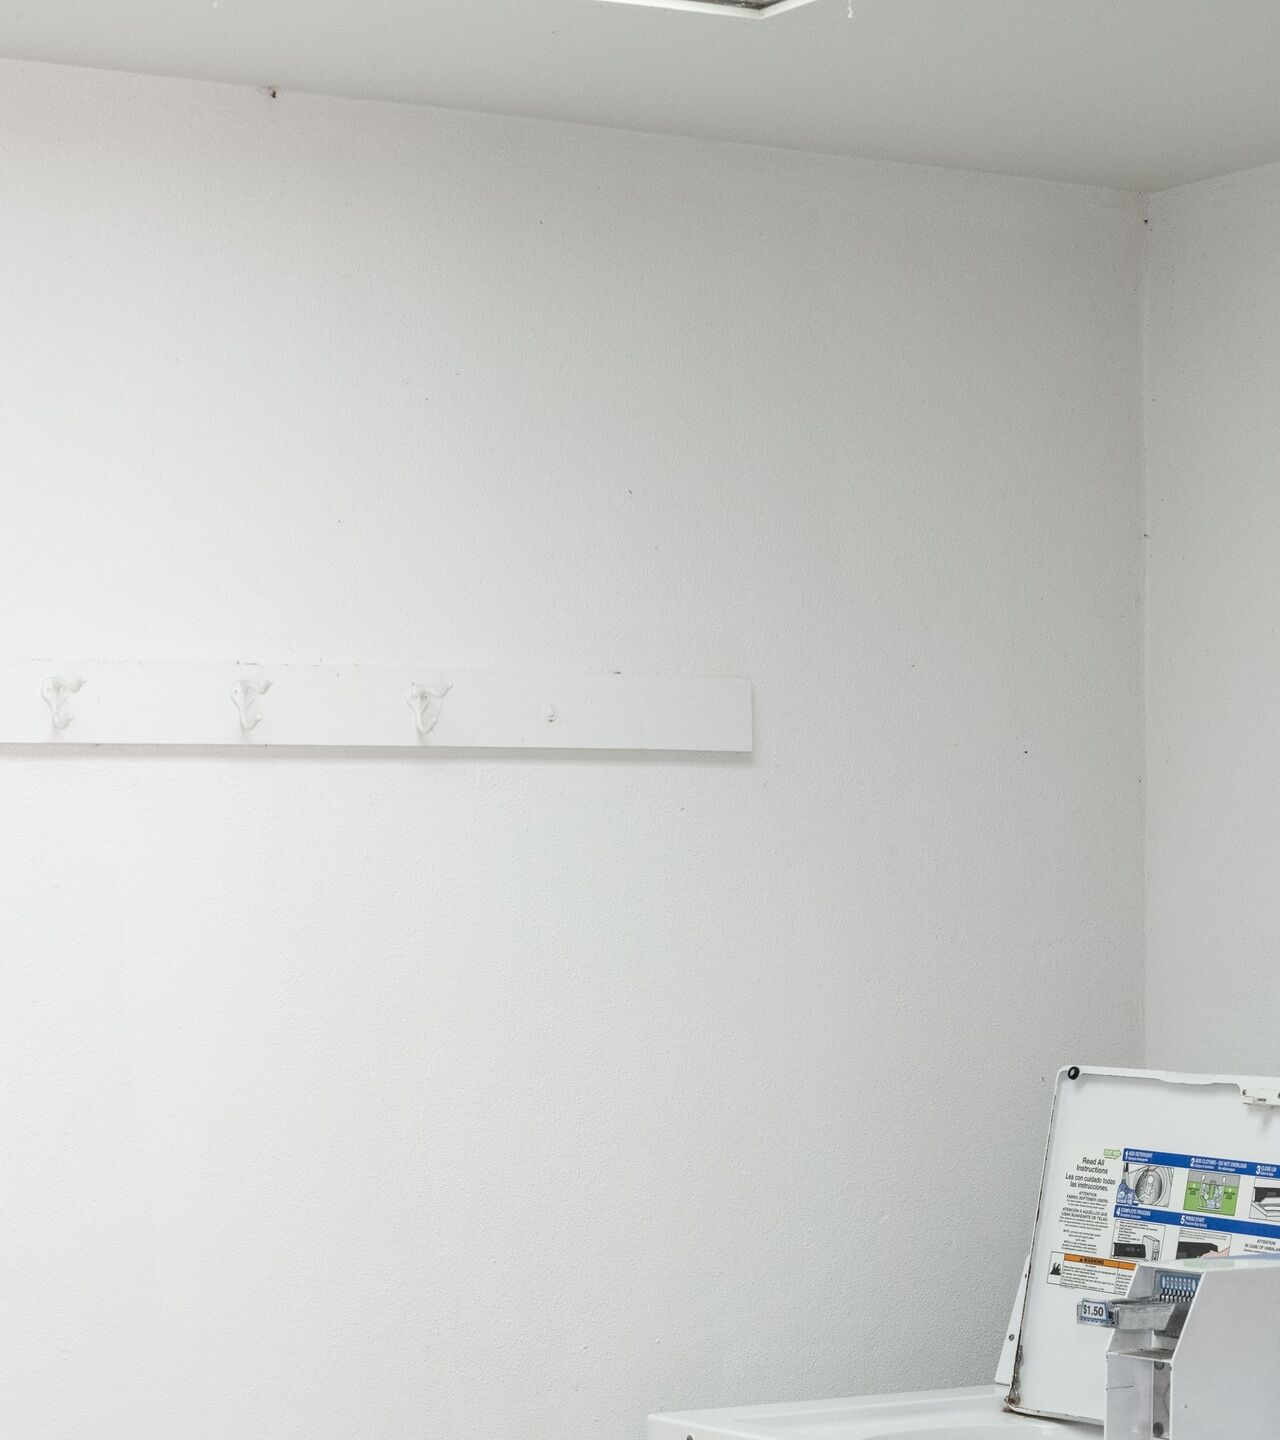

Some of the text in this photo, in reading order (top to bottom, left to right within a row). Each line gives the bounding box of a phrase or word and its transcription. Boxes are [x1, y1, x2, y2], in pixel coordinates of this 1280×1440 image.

[1190, 1157, 1196, 1167] 2
[1256, 1165, 1261, 1175] 3
[1180, 1215, 1185, 1225] 5
[1083, 1304, 1104, 1317] $1.50
